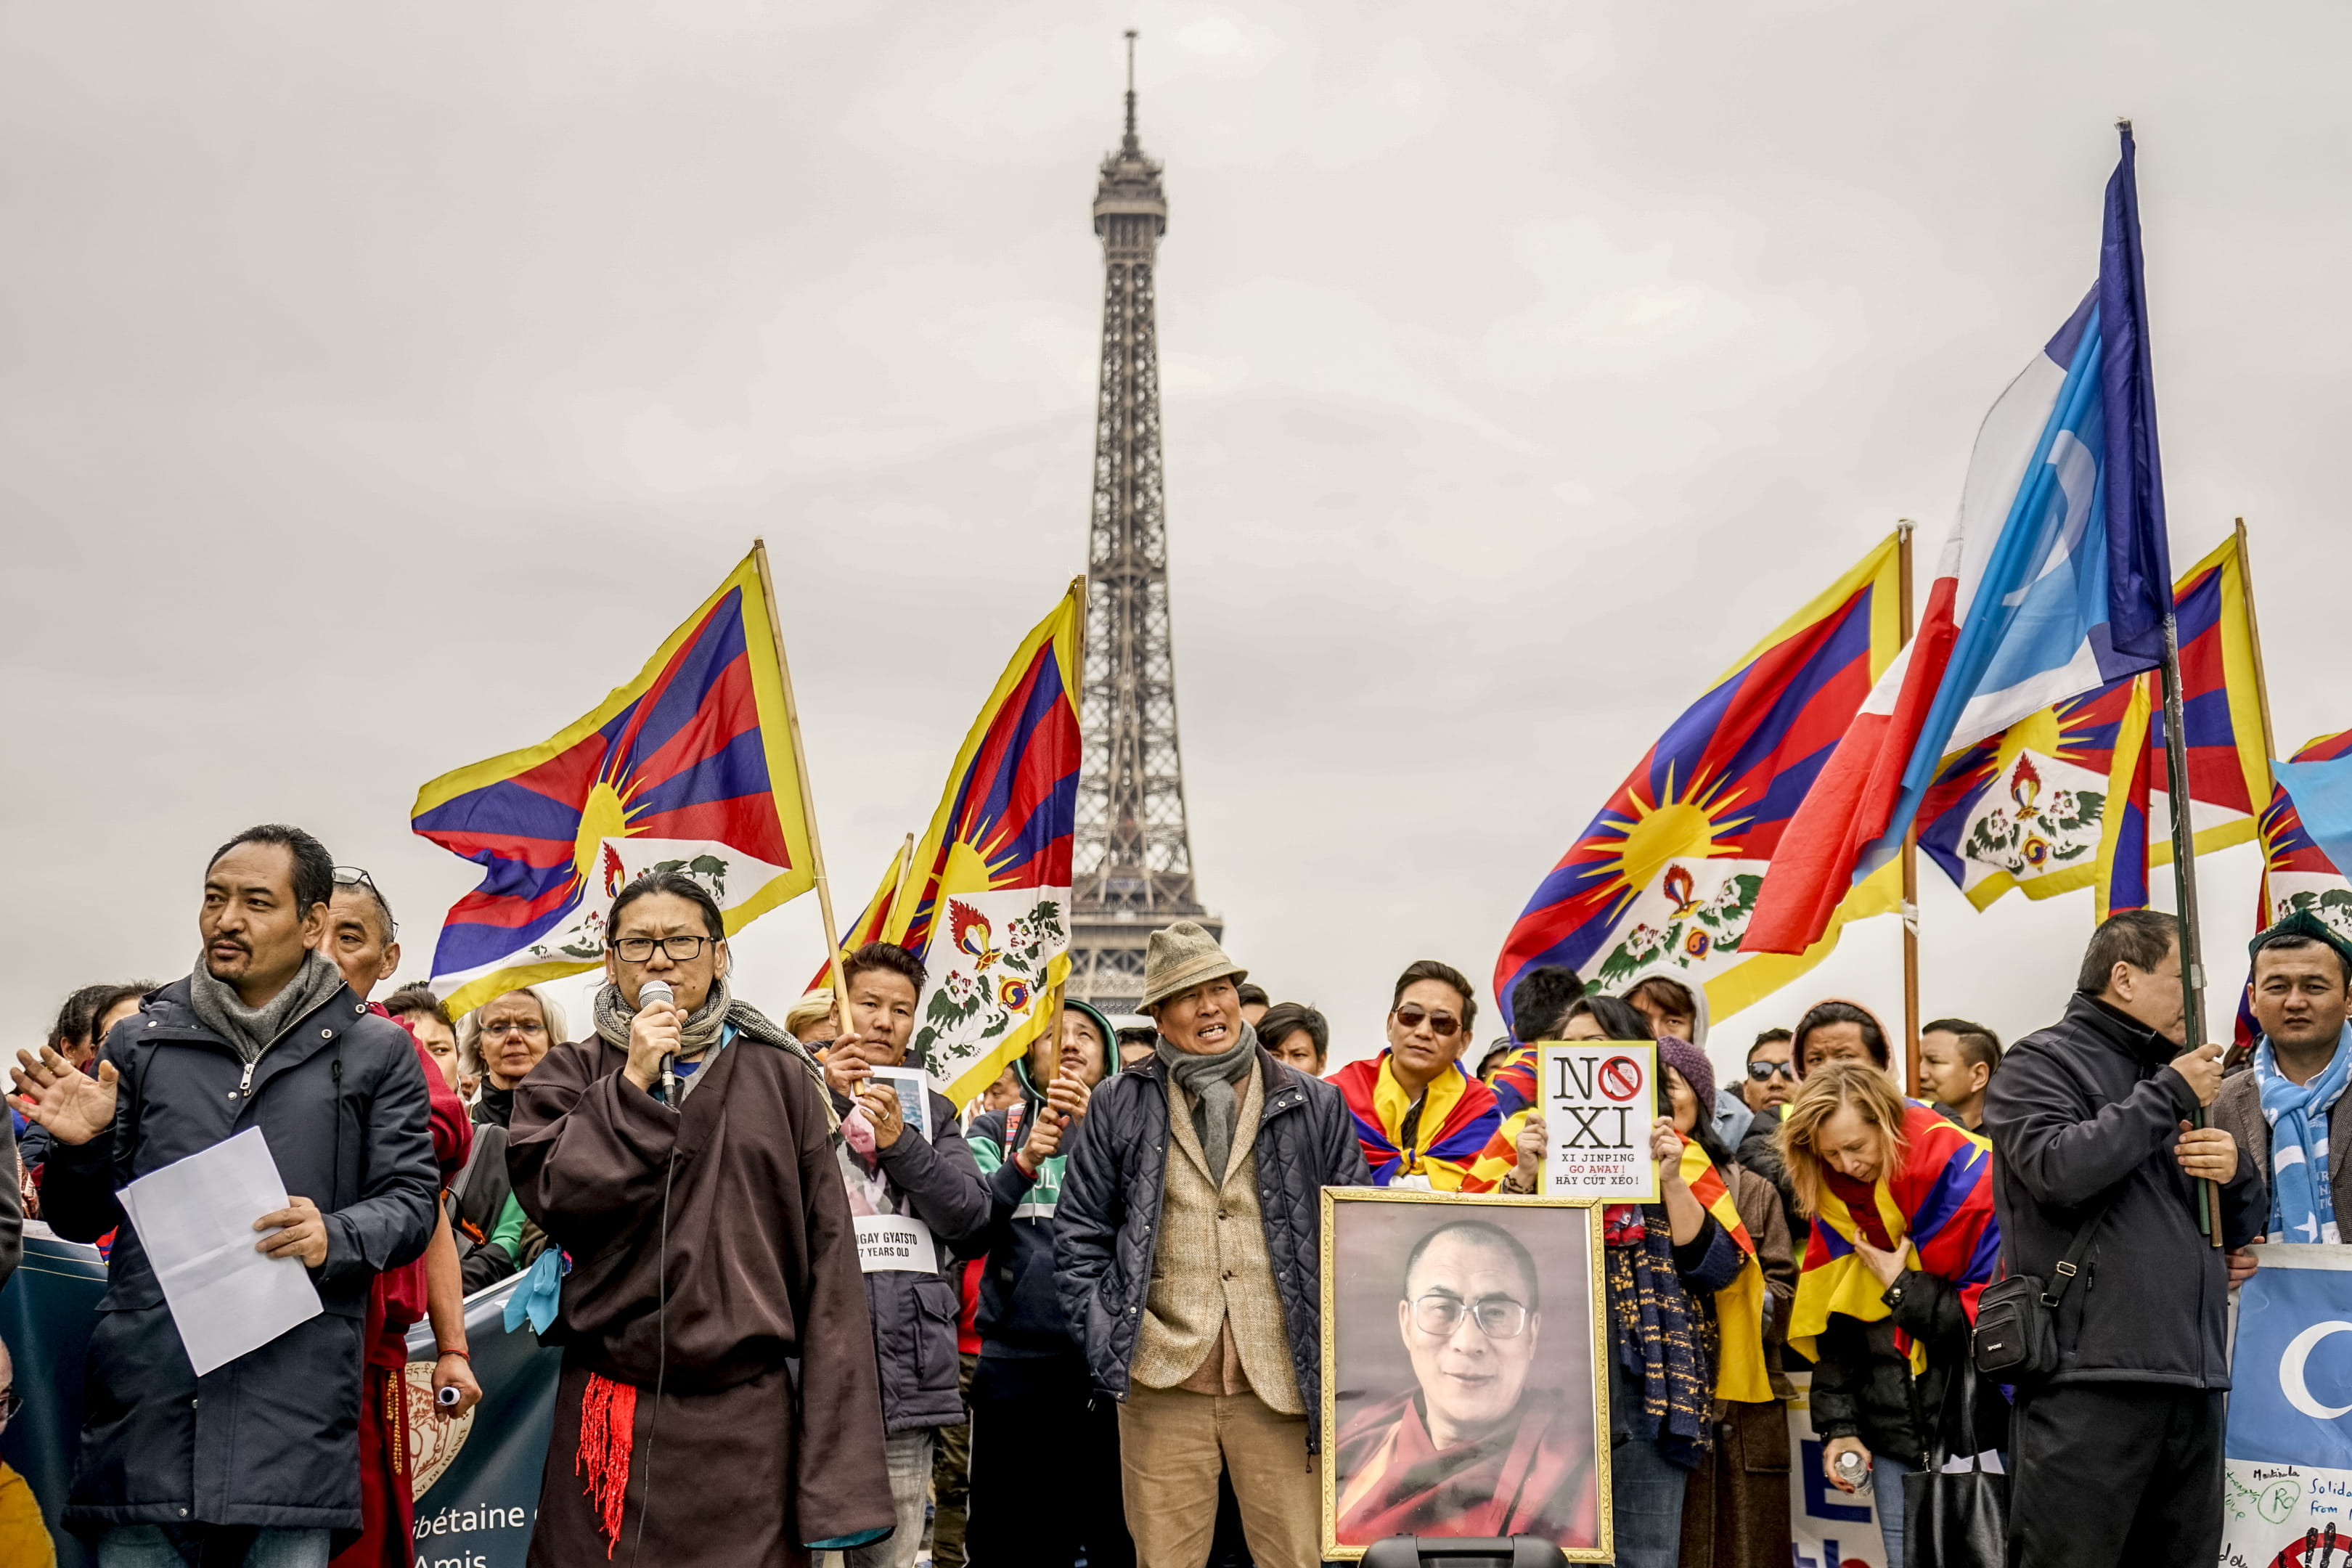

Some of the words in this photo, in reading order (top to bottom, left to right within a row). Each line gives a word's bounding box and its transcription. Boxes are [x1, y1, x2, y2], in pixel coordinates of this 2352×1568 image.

[1561, 1106, 1633, 1149] XI
[1562, 1153, 1576, 1162] XI
[1582, 1153, 1635, 1162] JINPING
[883, 1232, 918, 1245] GYATSTO
[867, 1247, 894, 1257] YEARS
[897, 1247, 909, 1257] OLD
[429, 1468, 441, 1482] DE
[441, 1426, 468, 1466] FRANCE
[2311, 1500, 2337, 1516] from
[412, 1503, 526, 1539] ibétaine
